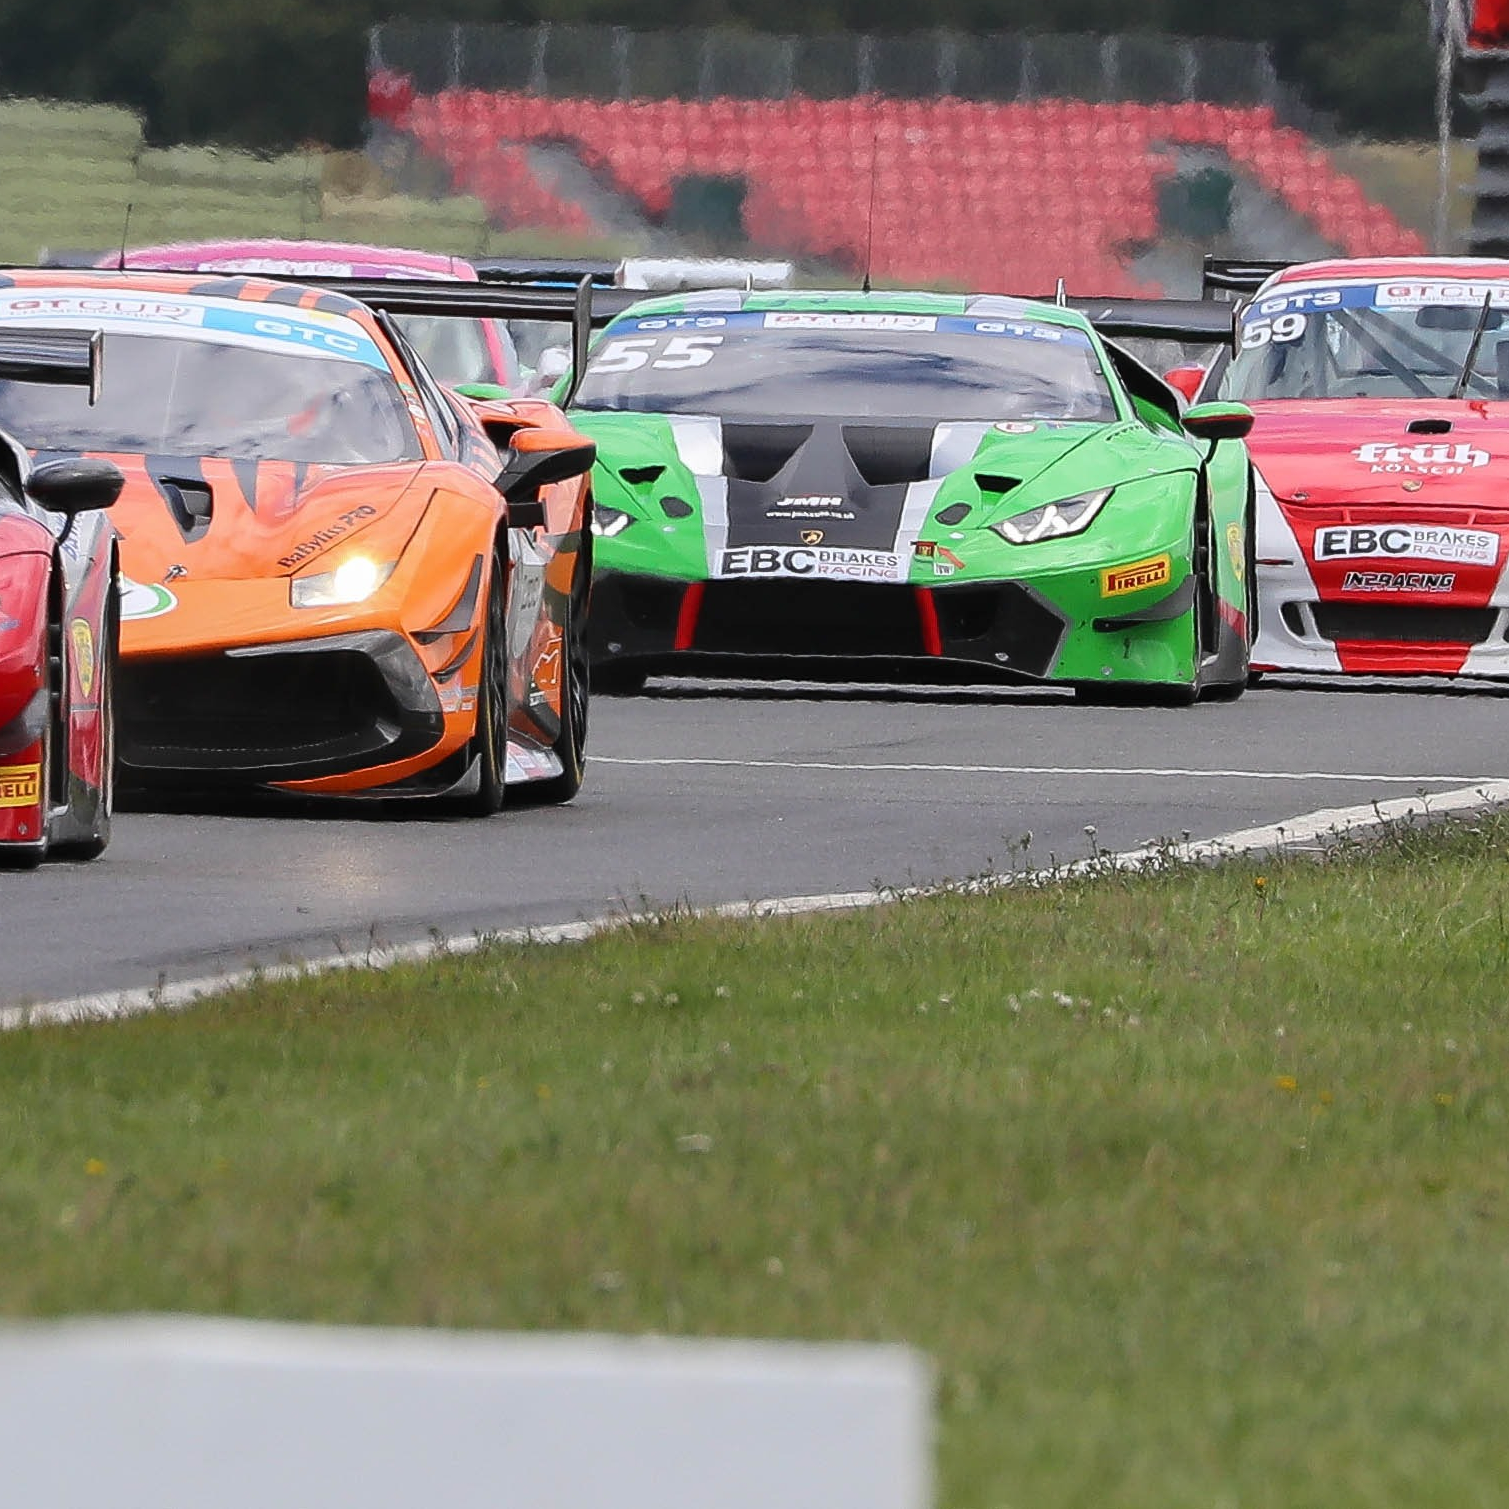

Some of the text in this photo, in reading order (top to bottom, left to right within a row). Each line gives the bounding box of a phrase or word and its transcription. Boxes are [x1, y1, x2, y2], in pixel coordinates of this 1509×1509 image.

[1260, 292, 1341, 314] GT3
[254, 319, 359, 352] GTC
[1241, 312, 1307, 349] 59
[589, 336, 725, 374] 55
[1322, 529, 1412, 557] EBC
[1412, 544, 1488, 560] RACING
[1413, 530, 1490, 548] BRAKES
[721, 549, 815, 575] EBC
[817, 565, 899, 579] RACING
[818, 552, 899, 567] BRAKES
[1107, 561, 1166, 592] PIRELLI
